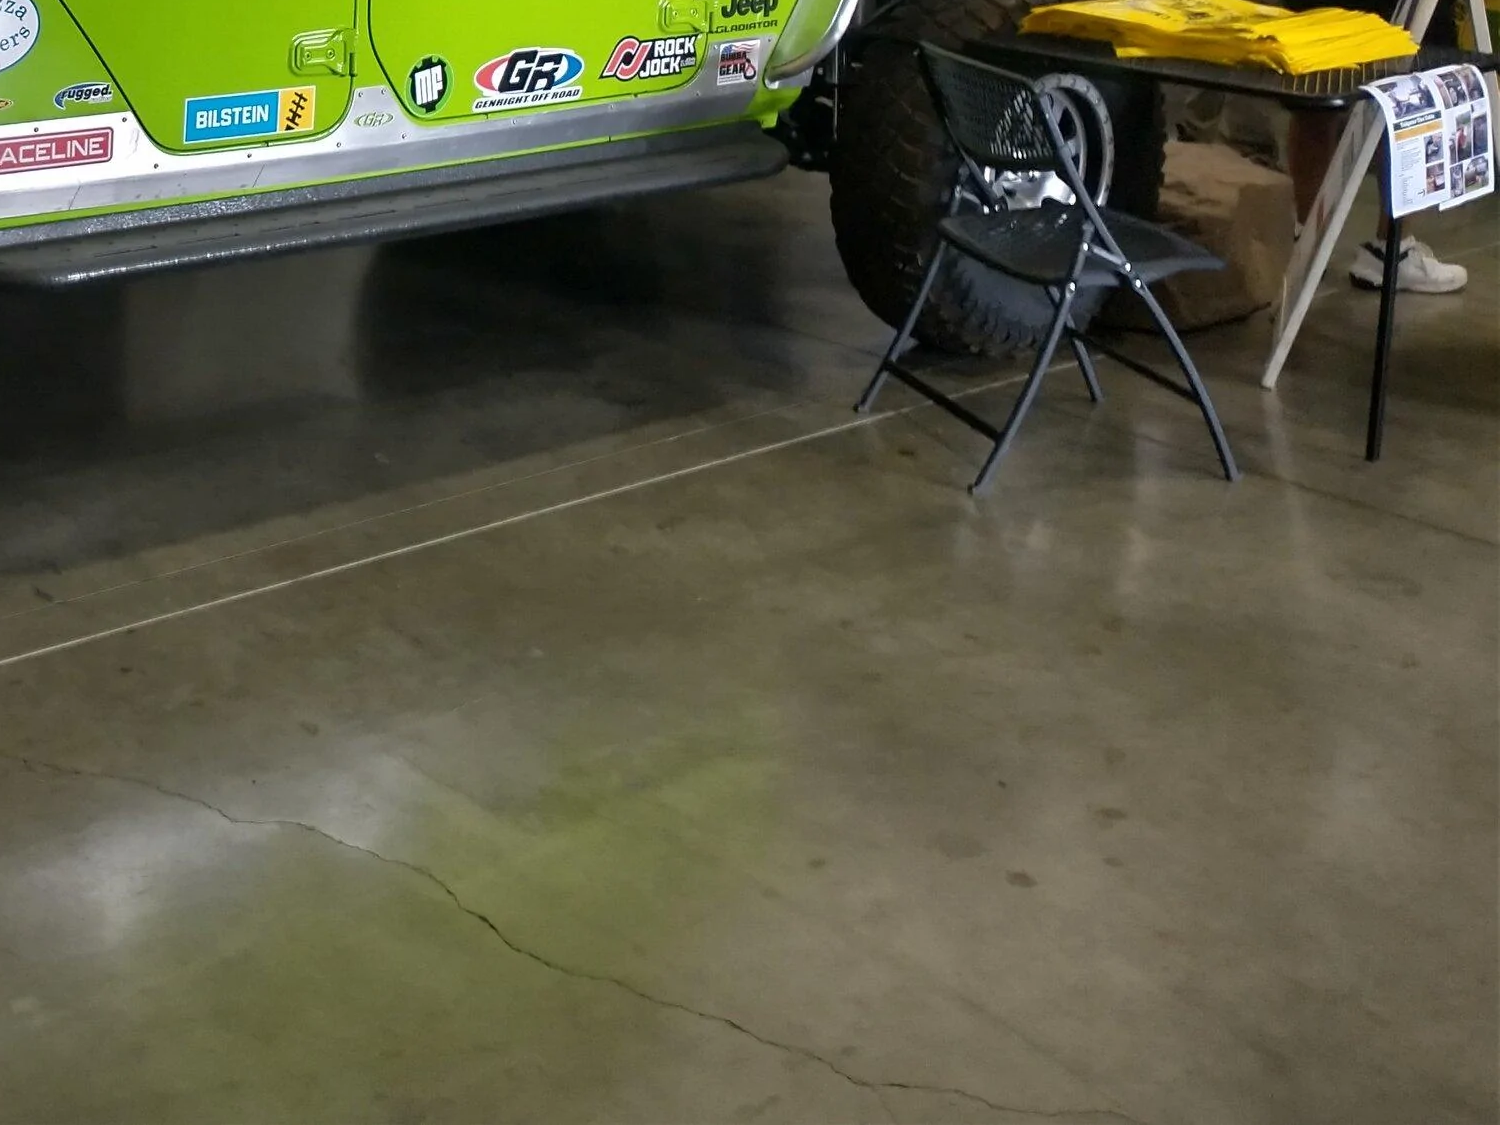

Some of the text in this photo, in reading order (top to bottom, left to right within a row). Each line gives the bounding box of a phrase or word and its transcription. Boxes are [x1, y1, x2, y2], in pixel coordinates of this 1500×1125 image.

[715, 19, 778, 34] GLADIATOR
[654, 36, 696, 58] ROCK
[498, 48, 559, 95] GR
[640, 56, 682, 78] JOCK
[720, 62, 746, 77] GEAR
[474, 88, 580, 110] GENRIGHT OFF ROAD
[195, 104, 270, 130] BILSTEIN
